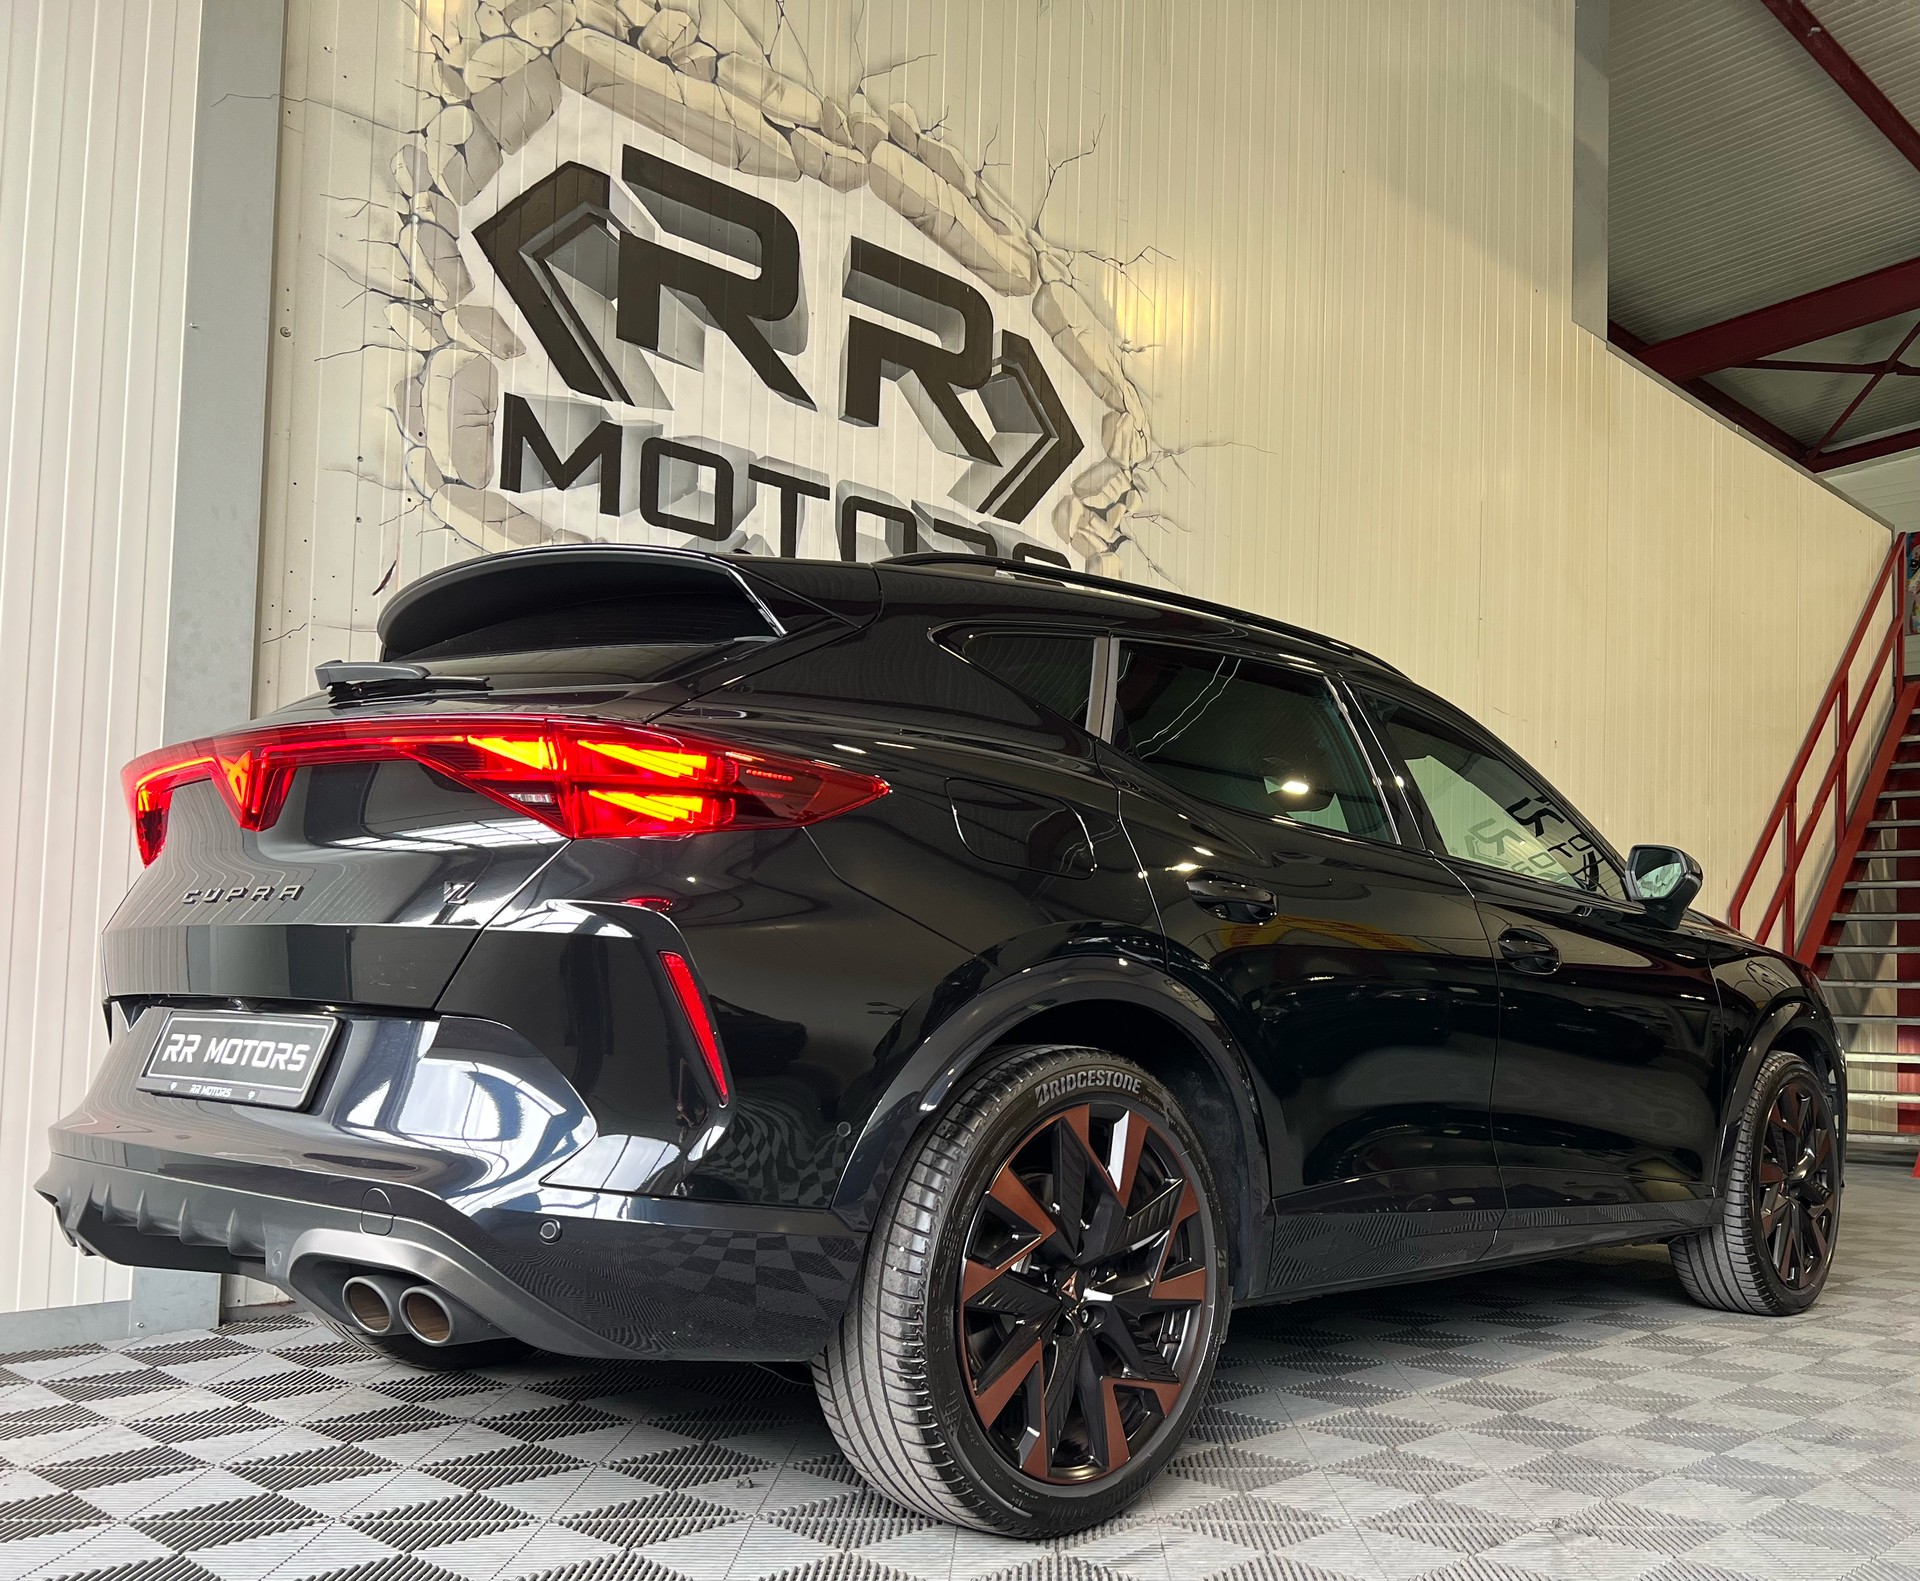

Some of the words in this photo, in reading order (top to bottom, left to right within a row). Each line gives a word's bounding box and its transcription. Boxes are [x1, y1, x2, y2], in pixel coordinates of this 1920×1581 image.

[616, 145, 1003, 466] RR
[500, 392, 1071, 569] MOTO
[182, 884, 305, 905] CUPRA
[162, 1034, 202, 1063] RR
[203, 1038, 311, 1072] MOTORS
[189, 1084, 202, 1094] RR
[201, 1085, 233, 1098] MOTORS
[1034, 1070, 1142, 1108] BRIDGESTONE
